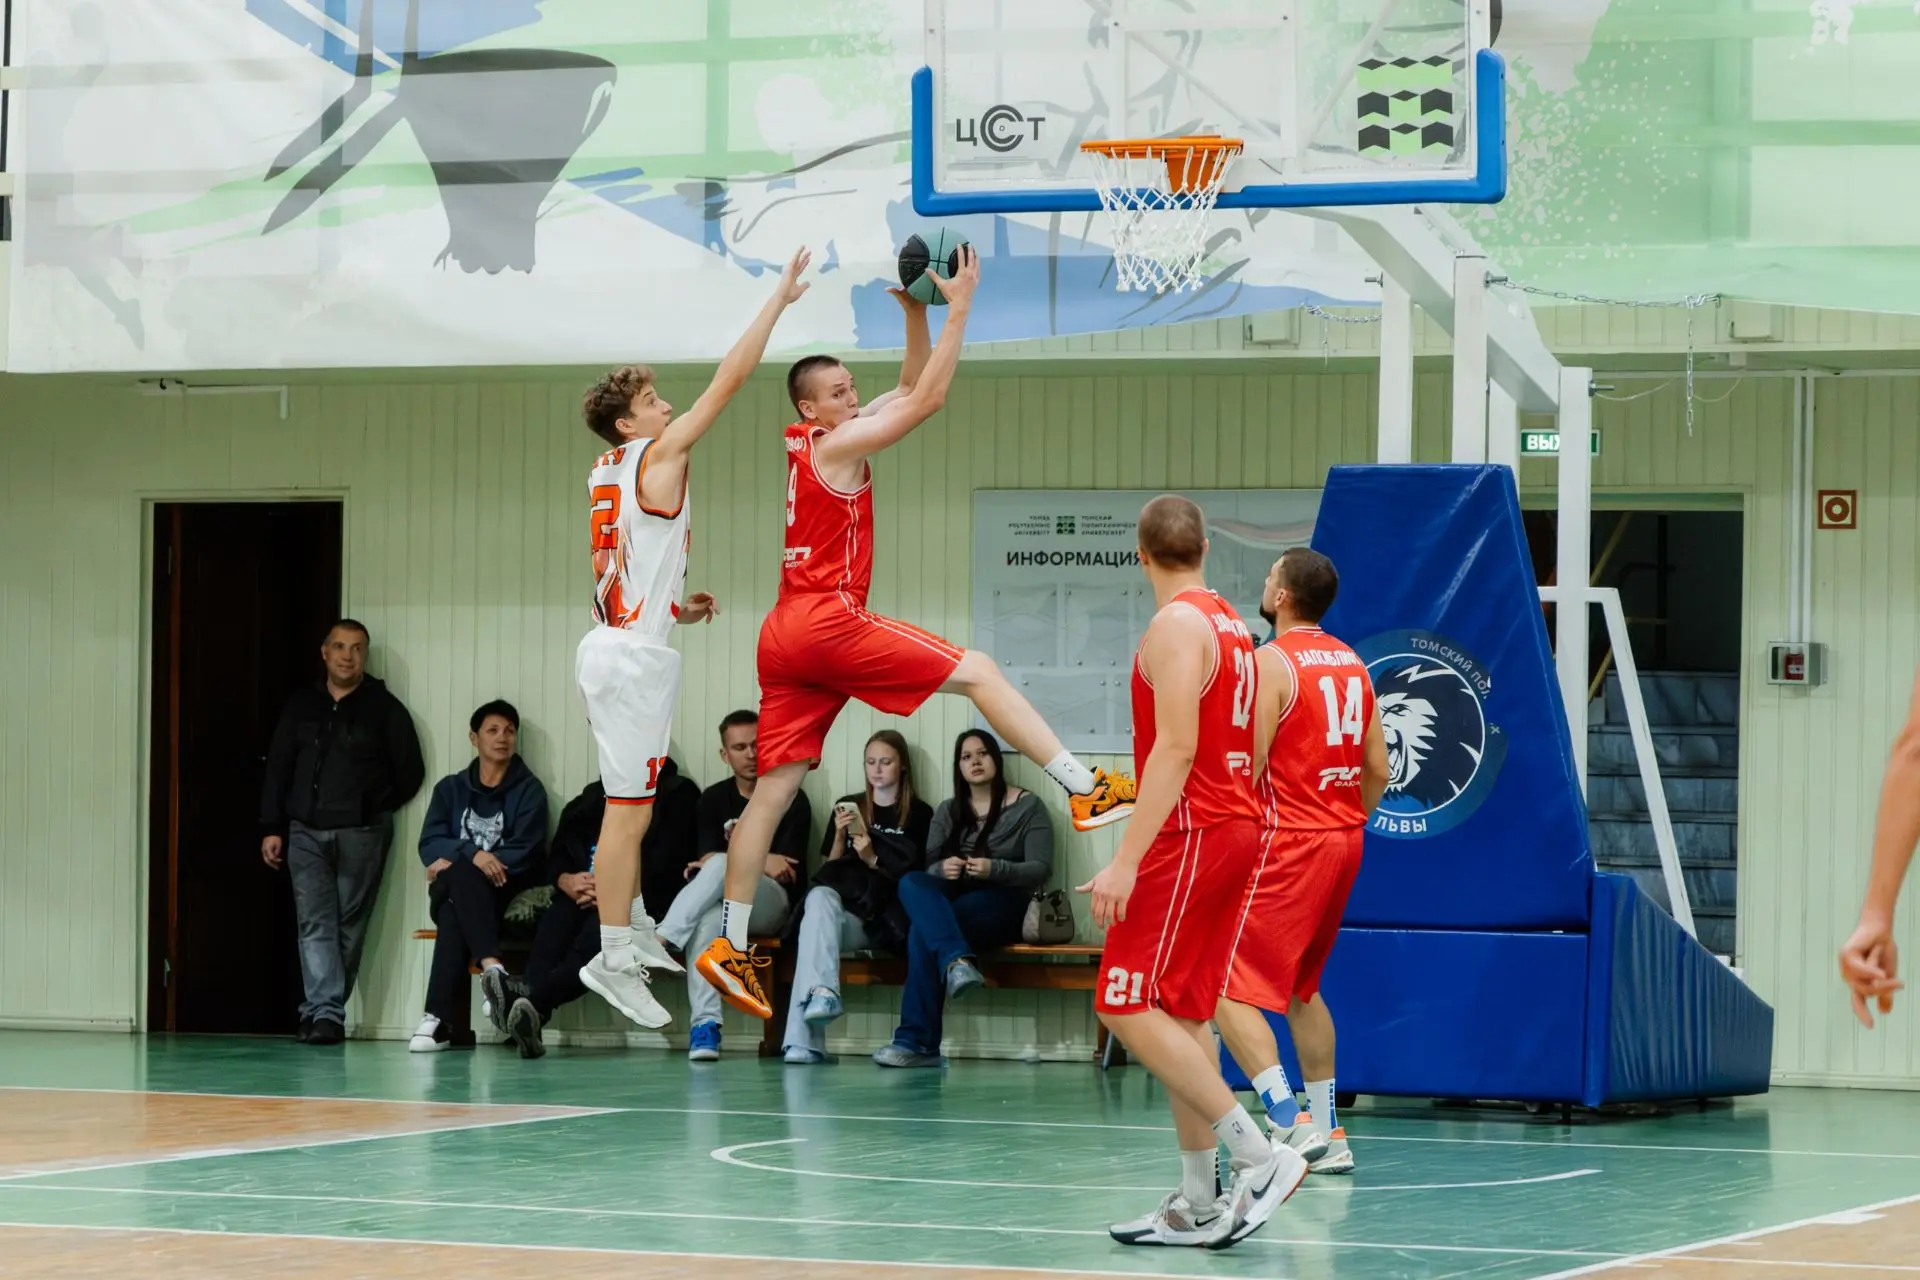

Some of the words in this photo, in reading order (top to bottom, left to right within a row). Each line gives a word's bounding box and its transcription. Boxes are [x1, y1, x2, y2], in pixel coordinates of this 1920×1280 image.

[1527, 434, 1560, 451] ВЫХ
[1411, 637, 1473, 673] ТОМСКИЙ
[1232, 647, 1256, 730] 21
[1318, 675, 1364, 746] 14
[1374, 815, 1427, 833] ЛЬВЫ
[1104, 966, 1144, 1006] 21
